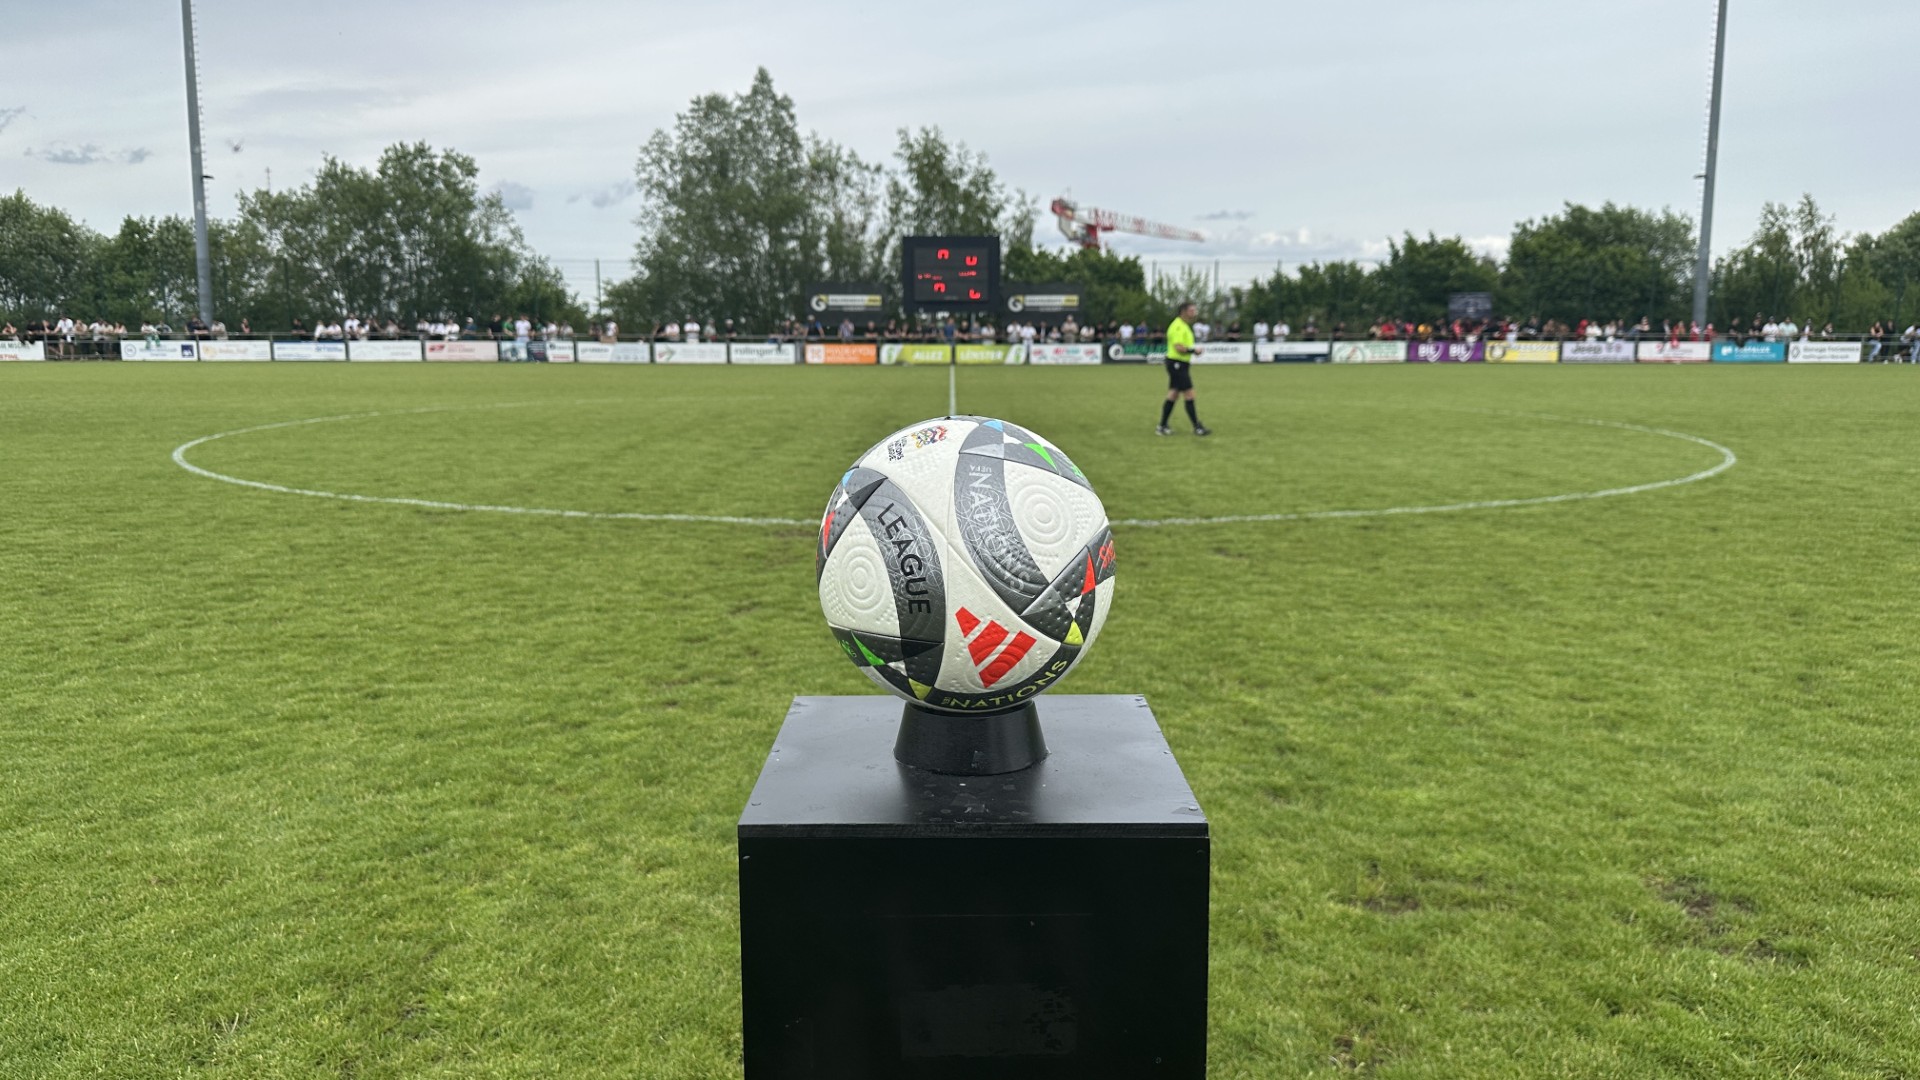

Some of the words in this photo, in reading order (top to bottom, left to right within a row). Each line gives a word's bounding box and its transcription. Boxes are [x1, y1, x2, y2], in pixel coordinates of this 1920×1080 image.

[912, 350, 943, 361] ALLEZ
[877, 502, 931, 614] LEAGUE
[950, 660, 1068, 708] NATIONS
